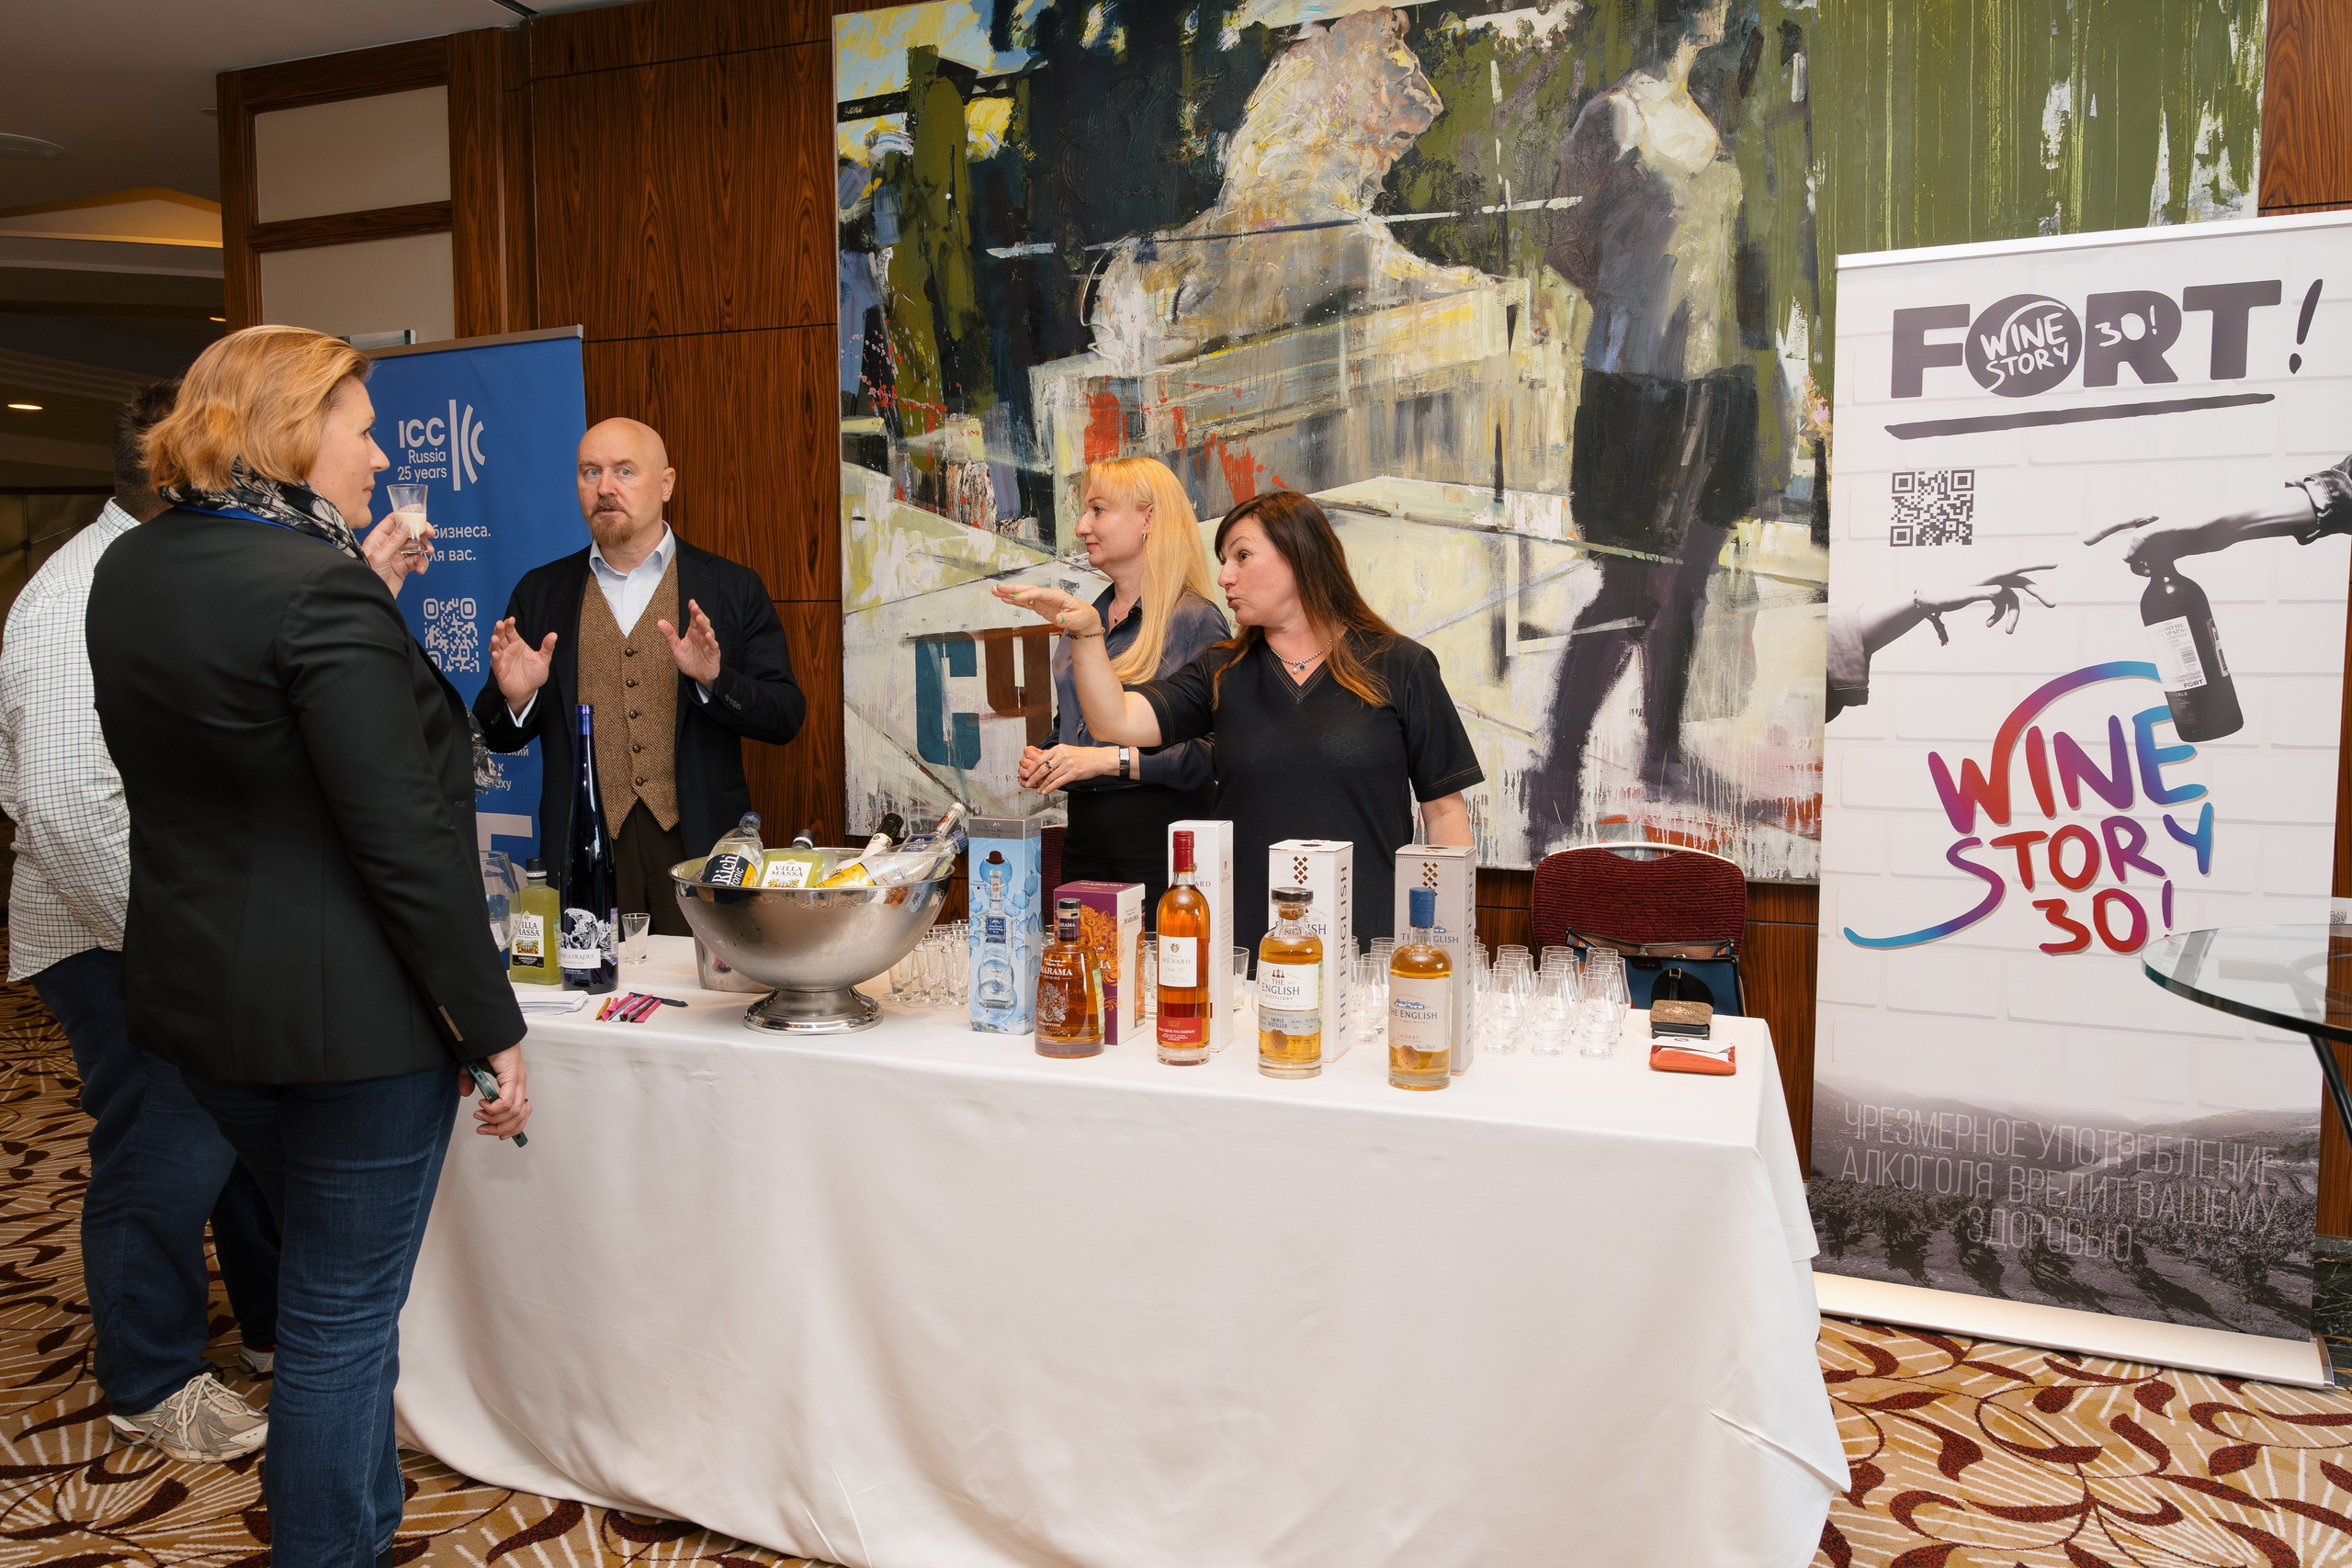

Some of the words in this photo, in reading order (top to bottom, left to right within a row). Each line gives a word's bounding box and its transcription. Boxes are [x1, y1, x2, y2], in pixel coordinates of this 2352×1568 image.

[1979, 300, 2068, 360] WINE
[2095, 304, 2157, 347] 30!
[1984, 341, 2070, 392] STORY
[399, 417, 446, 448] ICC
[408, 448, 447, 464] Russia
[397, 466, 412, 480] 25
[413, 467, 447, 482] years
[433, 525, 492, 539] бизнеса.
[448, 549, 477, 561] вас.
[2183, 678, 2204, 689] FORT
[1928, 661, 2208, 835] WINE
[711, 854, 739, 886] Rich
[1843, 802, 2214, 949] STORY
[2032, 880, 2175, 956] 30!
[1261, 982, 1301, 996] ENGLISH
[1272, 978, 1285, 987] THE
[1400, 1010, 1438, 1020] ENGLISH
[1845, 1102, 2028, 1158] ЧРЕЗМЕРНОЕ
[2037, 1125, 2279, 1186] УПОТРЕБЛЕНИЕ
[1840, 1147, 1993, 1196] АЛКОГОЛЯ
[2008, 1166, 2127, 1215] ВРЕДИТ
[2137, 1180, 2281, 1234] ВАШЕМУ
[1966, 1206, 2133, 1263] ЗДОРОВЬЮ
